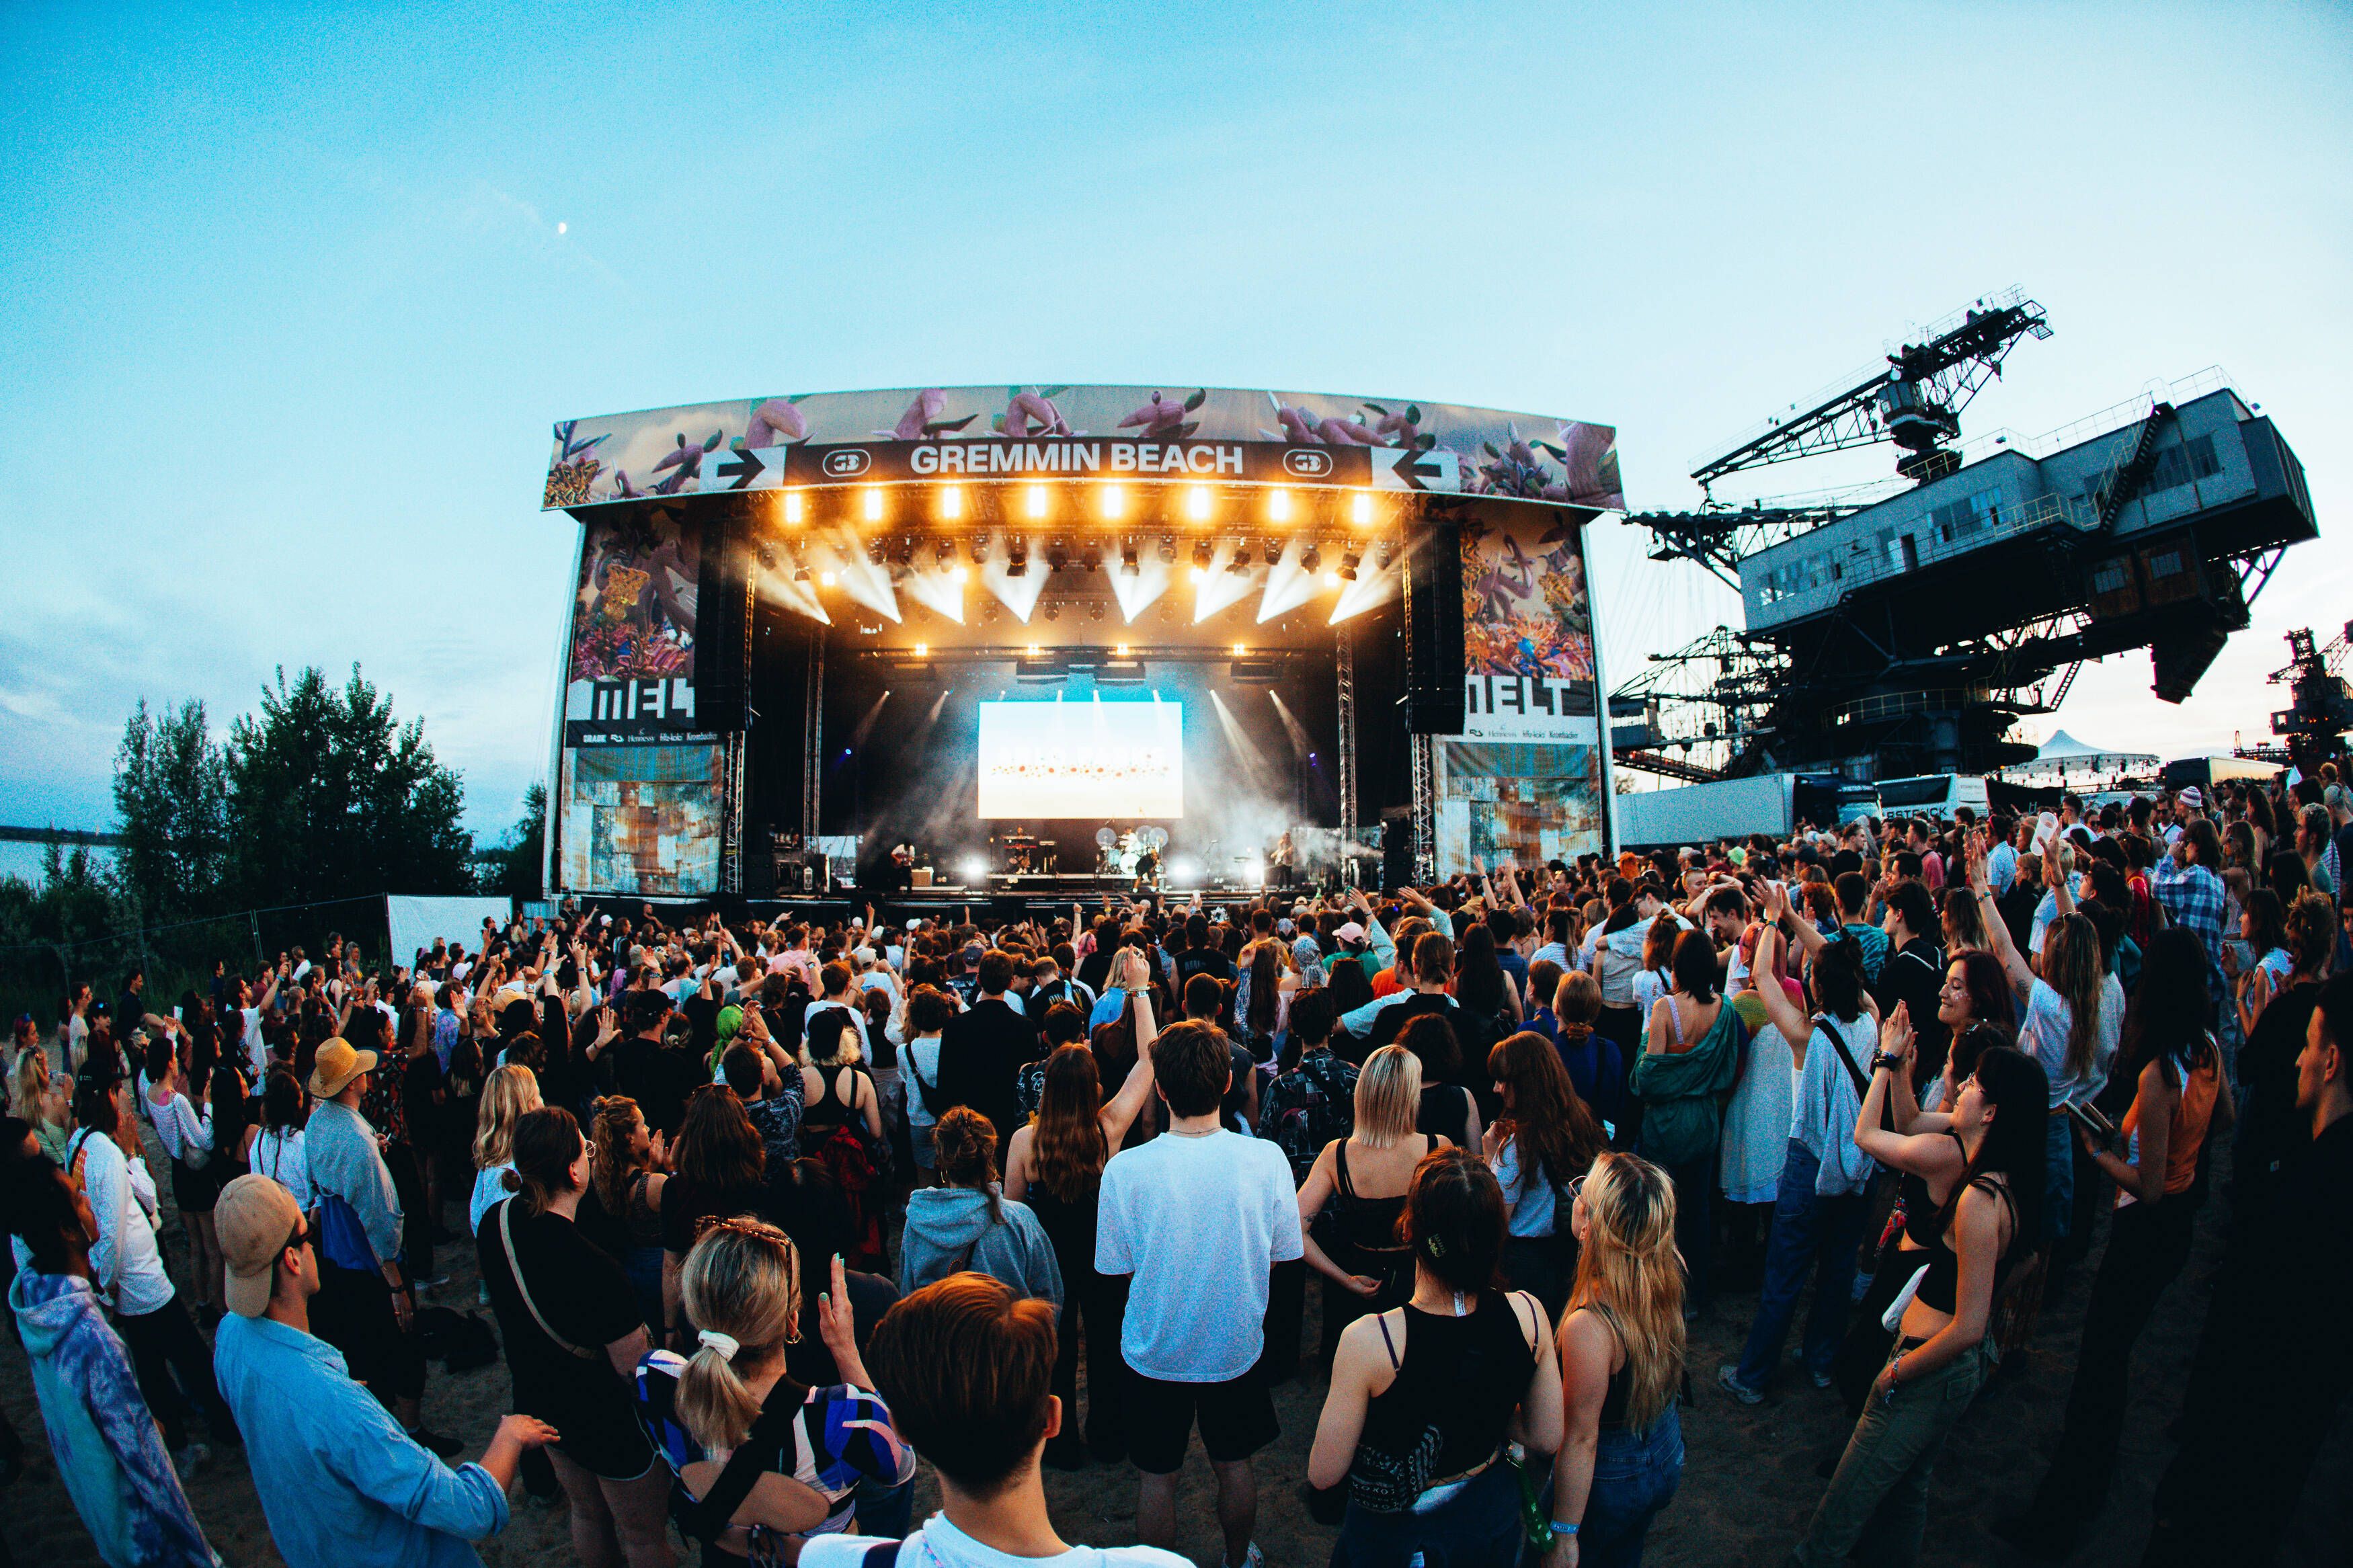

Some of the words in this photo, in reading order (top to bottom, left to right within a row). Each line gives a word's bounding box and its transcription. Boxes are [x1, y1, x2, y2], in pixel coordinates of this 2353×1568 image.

[910, 443, 1100, 474] GREMMIN
[1111, 443, 1243, 474] BEACH
[591, 678, 695, 720] MEL
